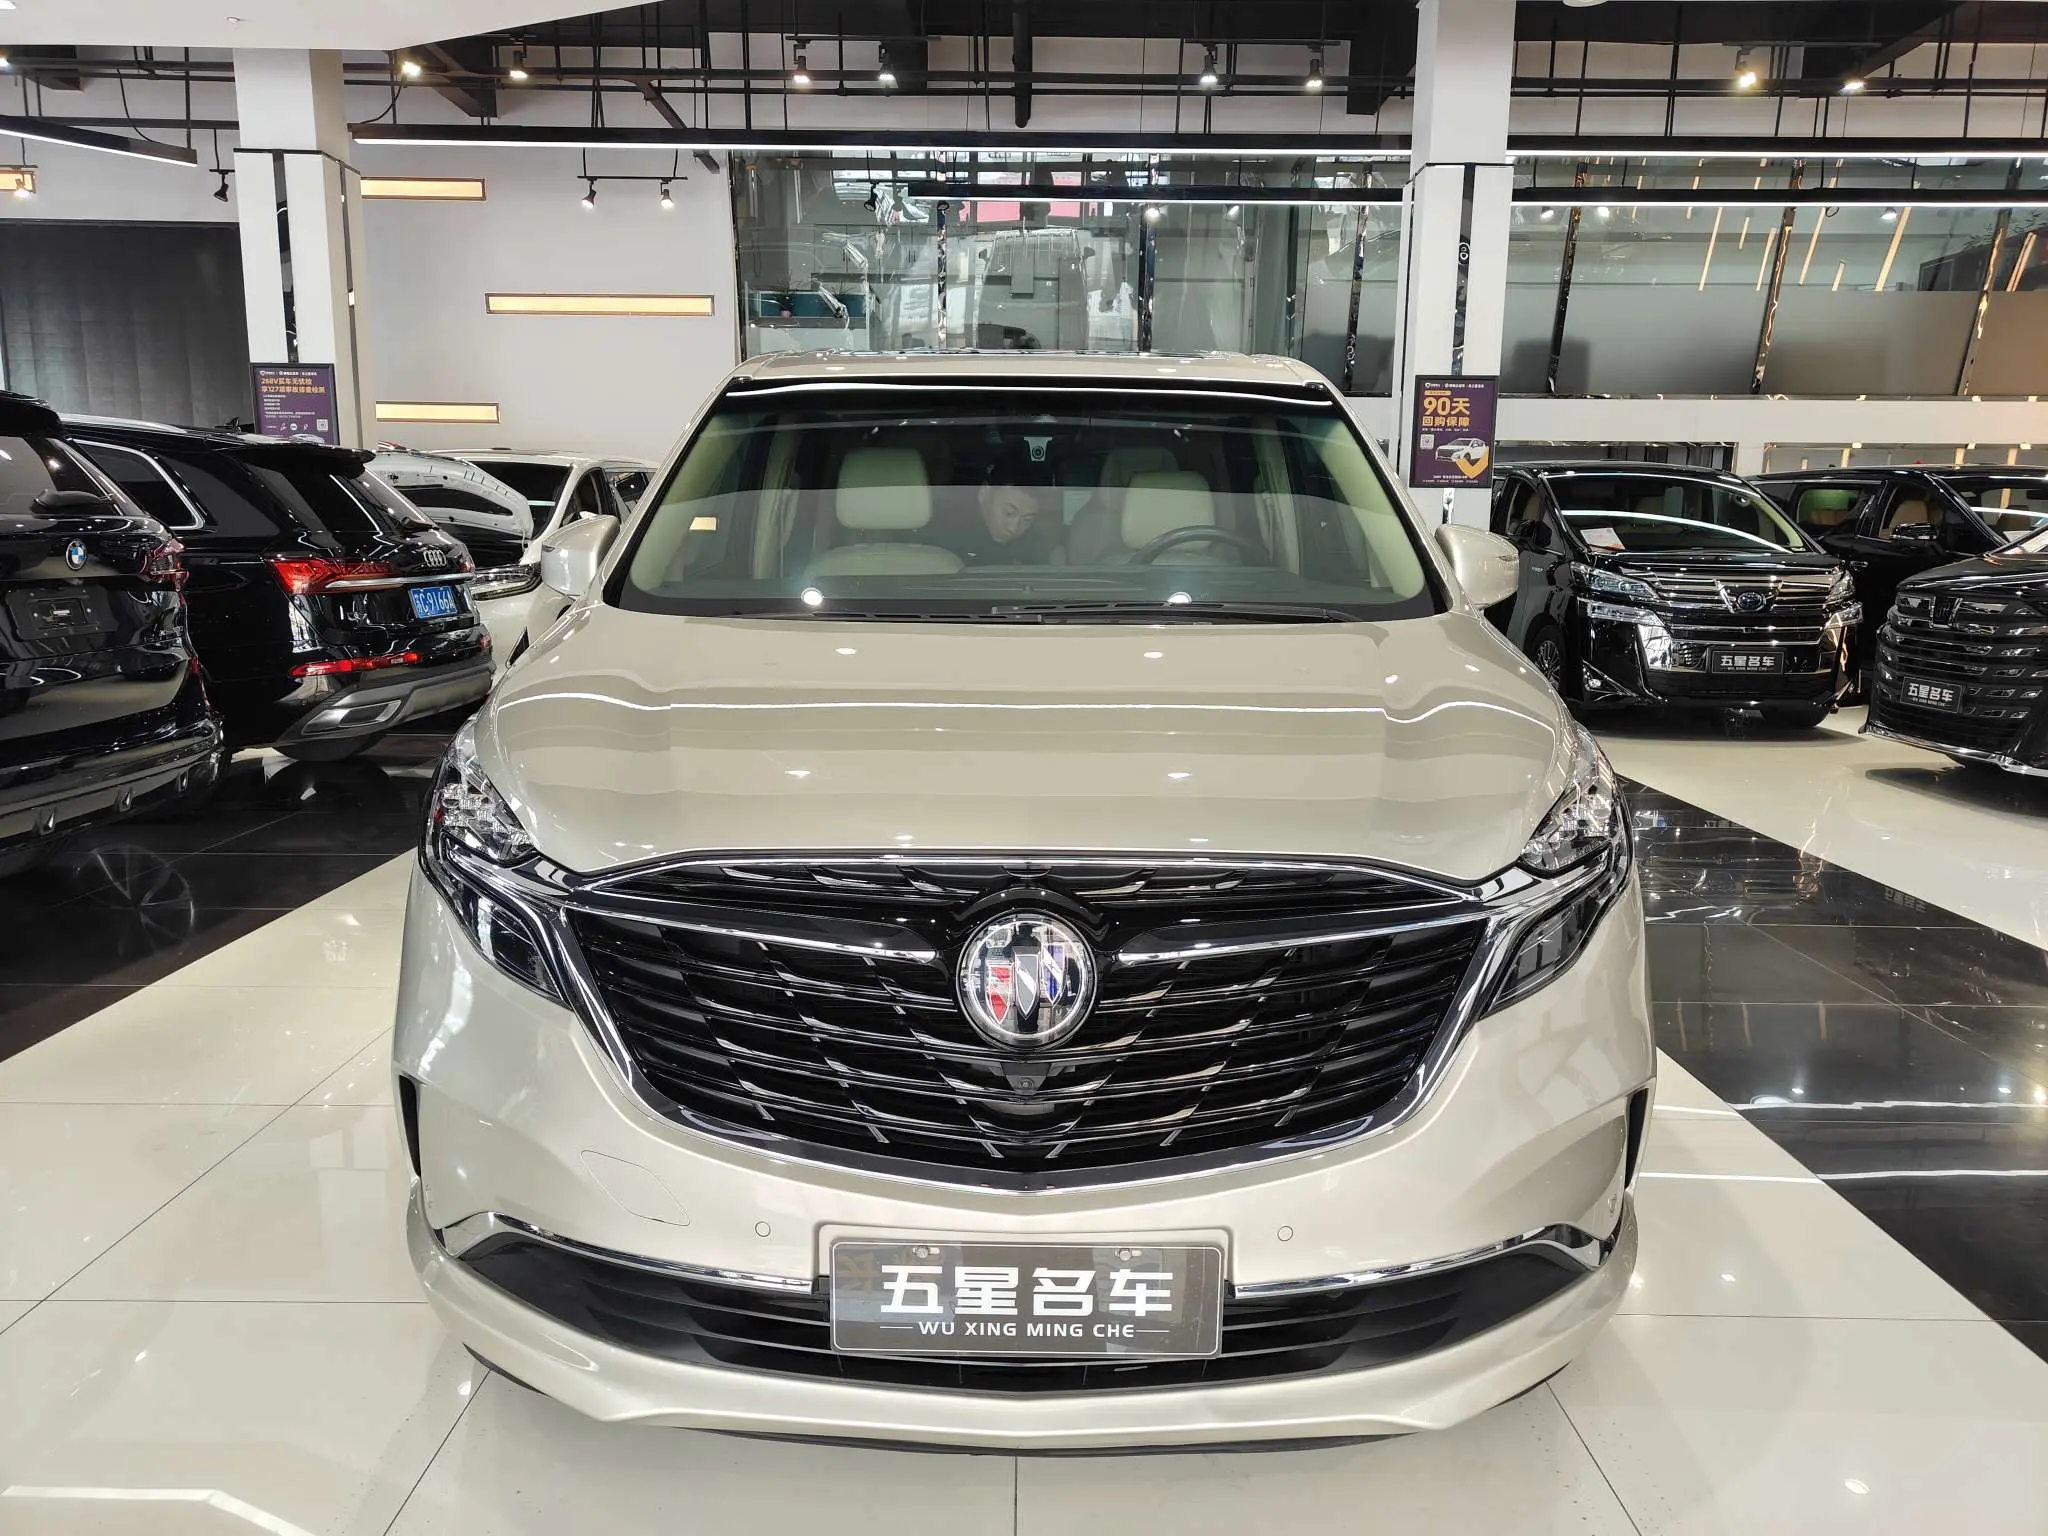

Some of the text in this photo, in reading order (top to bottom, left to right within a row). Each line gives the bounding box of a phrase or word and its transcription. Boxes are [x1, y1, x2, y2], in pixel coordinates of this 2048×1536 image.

[1423, 397, 1470, 415] 90天
[1422, 416, 1470, 427] 回购保障
[1720, 655, 1775, 667] 五星名车
[1907, 682, 1954, 702] 五星名车
[880, 1265, 1174, 1317] 五星名车
[918, 1320, 1136, 1338] WU XING MING CHE
